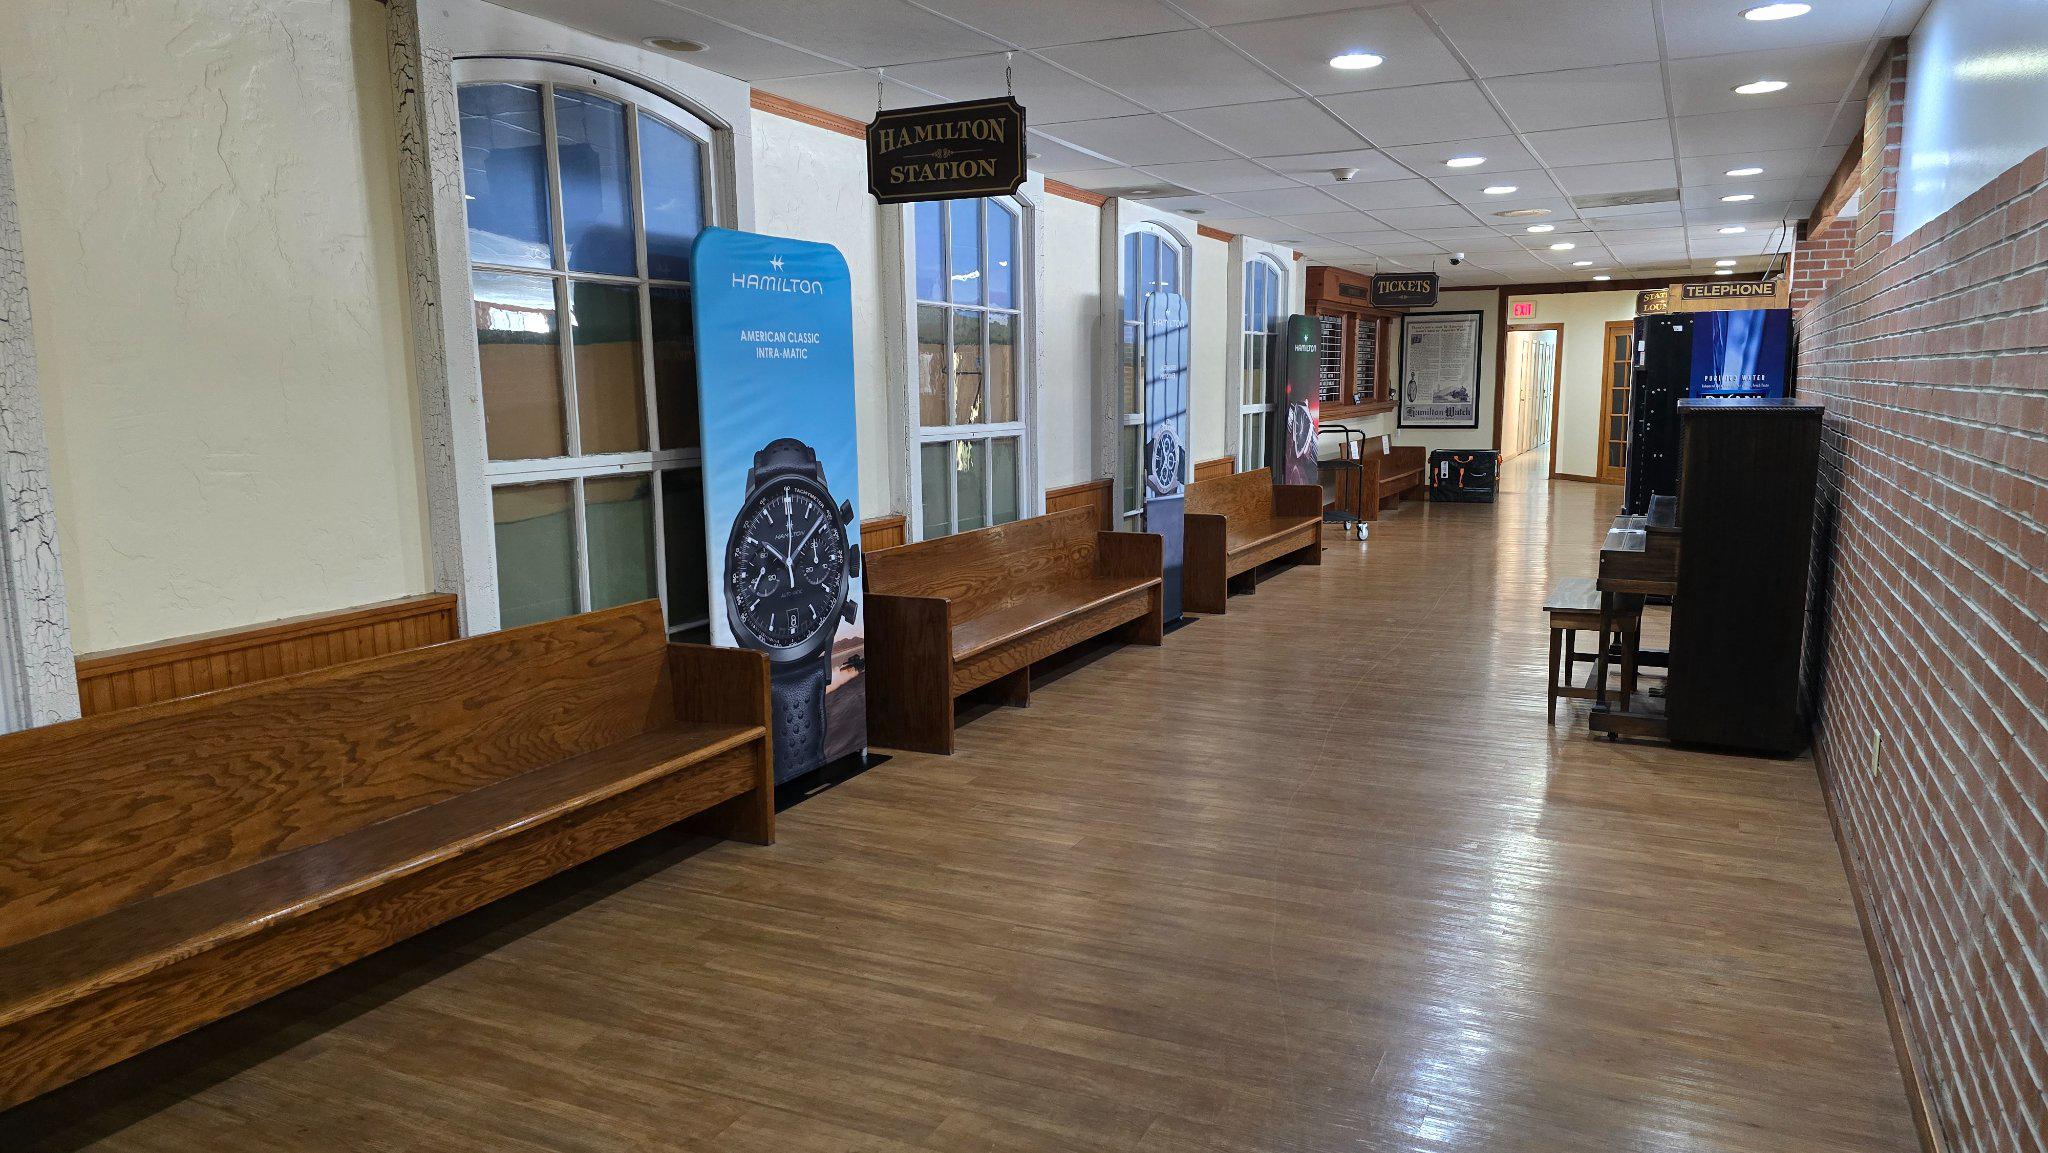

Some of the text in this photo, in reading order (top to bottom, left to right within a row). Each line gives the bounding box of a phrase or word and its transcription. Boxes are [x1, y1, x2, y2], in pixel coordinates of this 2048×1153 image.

[879, 117, 1007, 155] HAMILTON
[890, 158, 998, 184] STATION
[732, 273, 823, 295] HAMILTON
[1377, 280, 1431, 294] TICKETS
[1686, 283, 1773, 297] TELEPHONE
[1513, 303, 1533, 317] EXIT
[740, 330, 820, 344] AMERICAN CLASSIC
[756, 347, 808, 359] INTRA-MATIC
[1406, 406, 1471, 417] Hamilton Watch
[794, 487, 825, 509] TACHYMETER
[774, 530, 806, 541] HAMLTON
